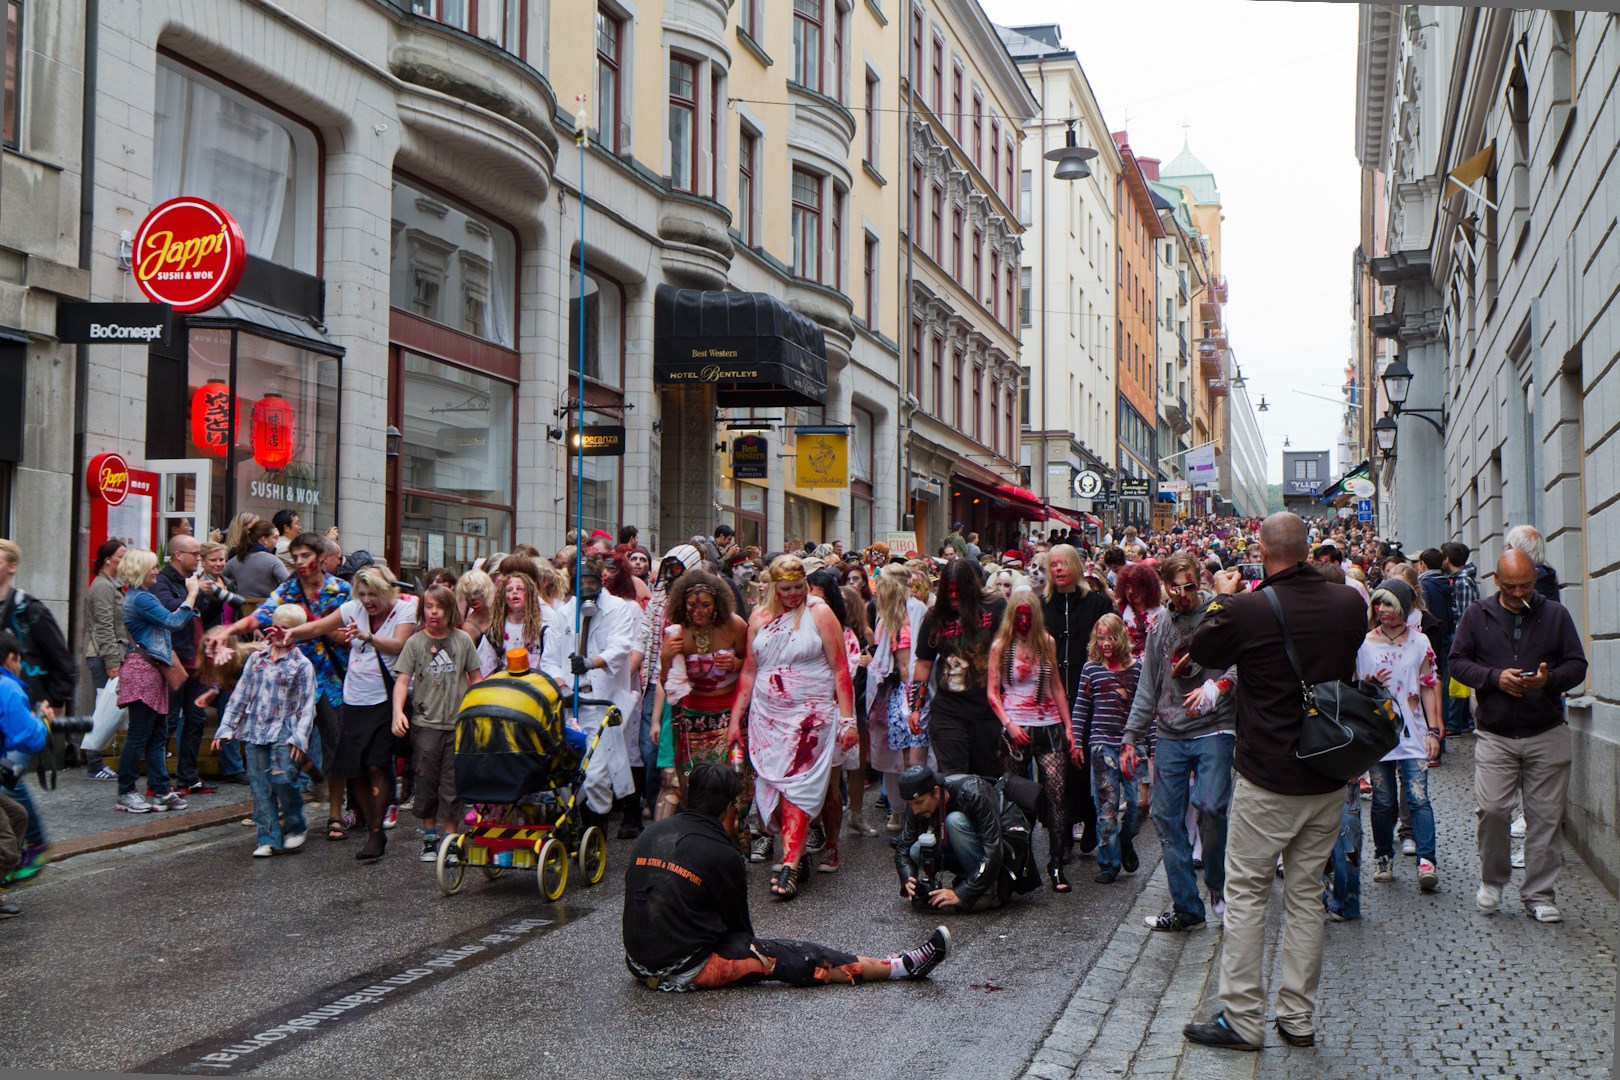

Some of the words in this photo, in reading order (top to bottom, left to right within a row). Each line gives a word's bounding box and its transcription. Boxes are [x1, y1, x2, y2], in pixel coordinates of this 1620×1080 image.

[139, 223, 227, 281] Jappi
[157, 271, 184, 280] SUSHI
[193, 271, 214, 280] WOK
[90, 323, 162, 342] BoConcept
[692, 349, 708, 358] Best
[709, 349, 738, 357] Western
[574, 434, 619, 444] peranza
[741, 445, 758, 453] Best
[736, 451, 765, 460] Western
[99, 467, 128, 491] Jappi
[130, 480, 150, 491] meny
[251, 481, 284, 500] SUSHI
[286, 486, 294, 502] &
[296, 486, 320, 505] WOK
[889, 540, 915, 552] CIBO
[647, 858, 662, 867] STEN
[423, 945, 487, 967] synd
[382, 968, 434, 984] om
